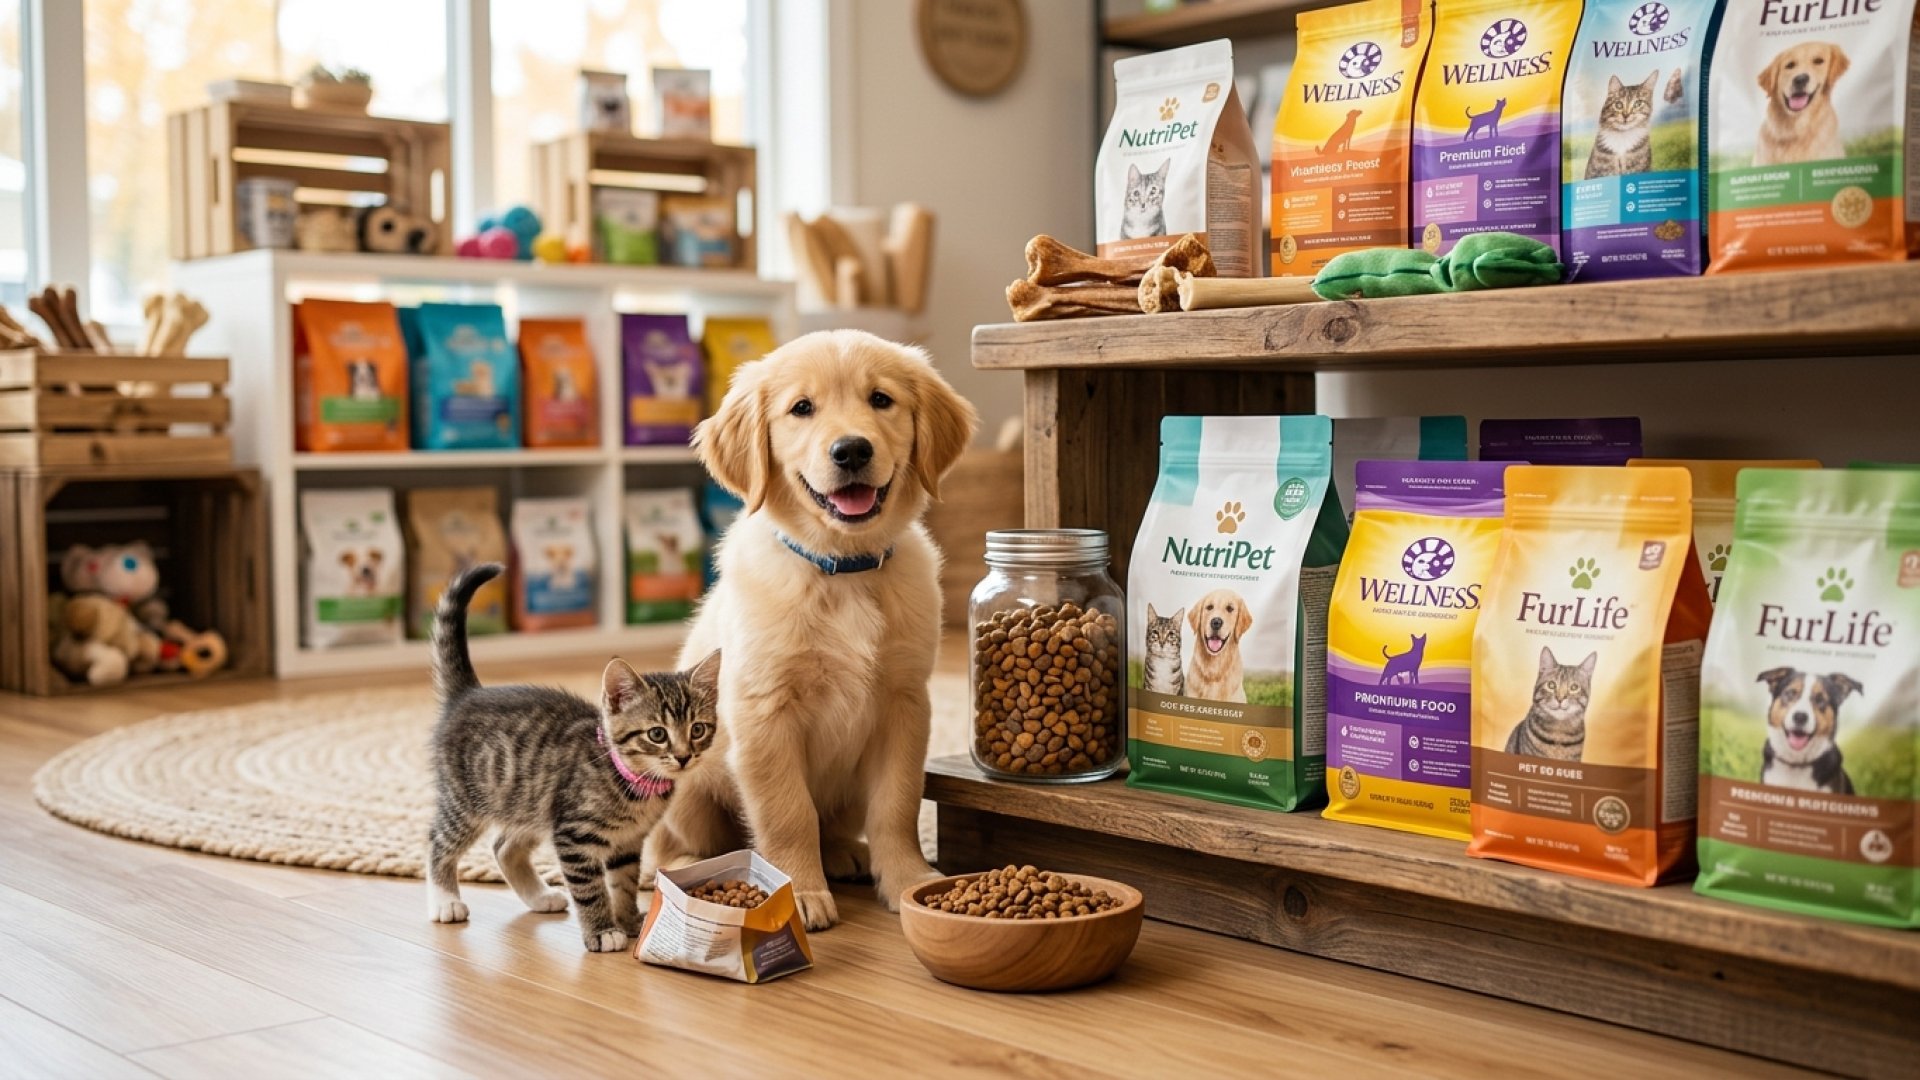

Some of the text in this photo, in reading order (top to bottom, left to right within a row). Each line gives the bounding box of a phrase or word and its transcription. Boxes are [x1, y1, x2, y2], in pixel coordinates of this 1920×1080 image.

[1592, 27, 1691, 58] WELLNESS
[1443, 51, 1552, 86] WELLNESS
[1303, 70, 1404, 103] WELLNESS
[1119, 121, 1198, 148] NutriPet
[1440, 149, 1491, 162] Premium
[1162, 536, 1276, 570] NutriPet
[1360, 577, 1481, 609] WELLNESS
[1516, 591, 1629, 629] FurLife
[1756, 603, 1893, 647] FurLife
[1519, 762, 1538, 774] PET
